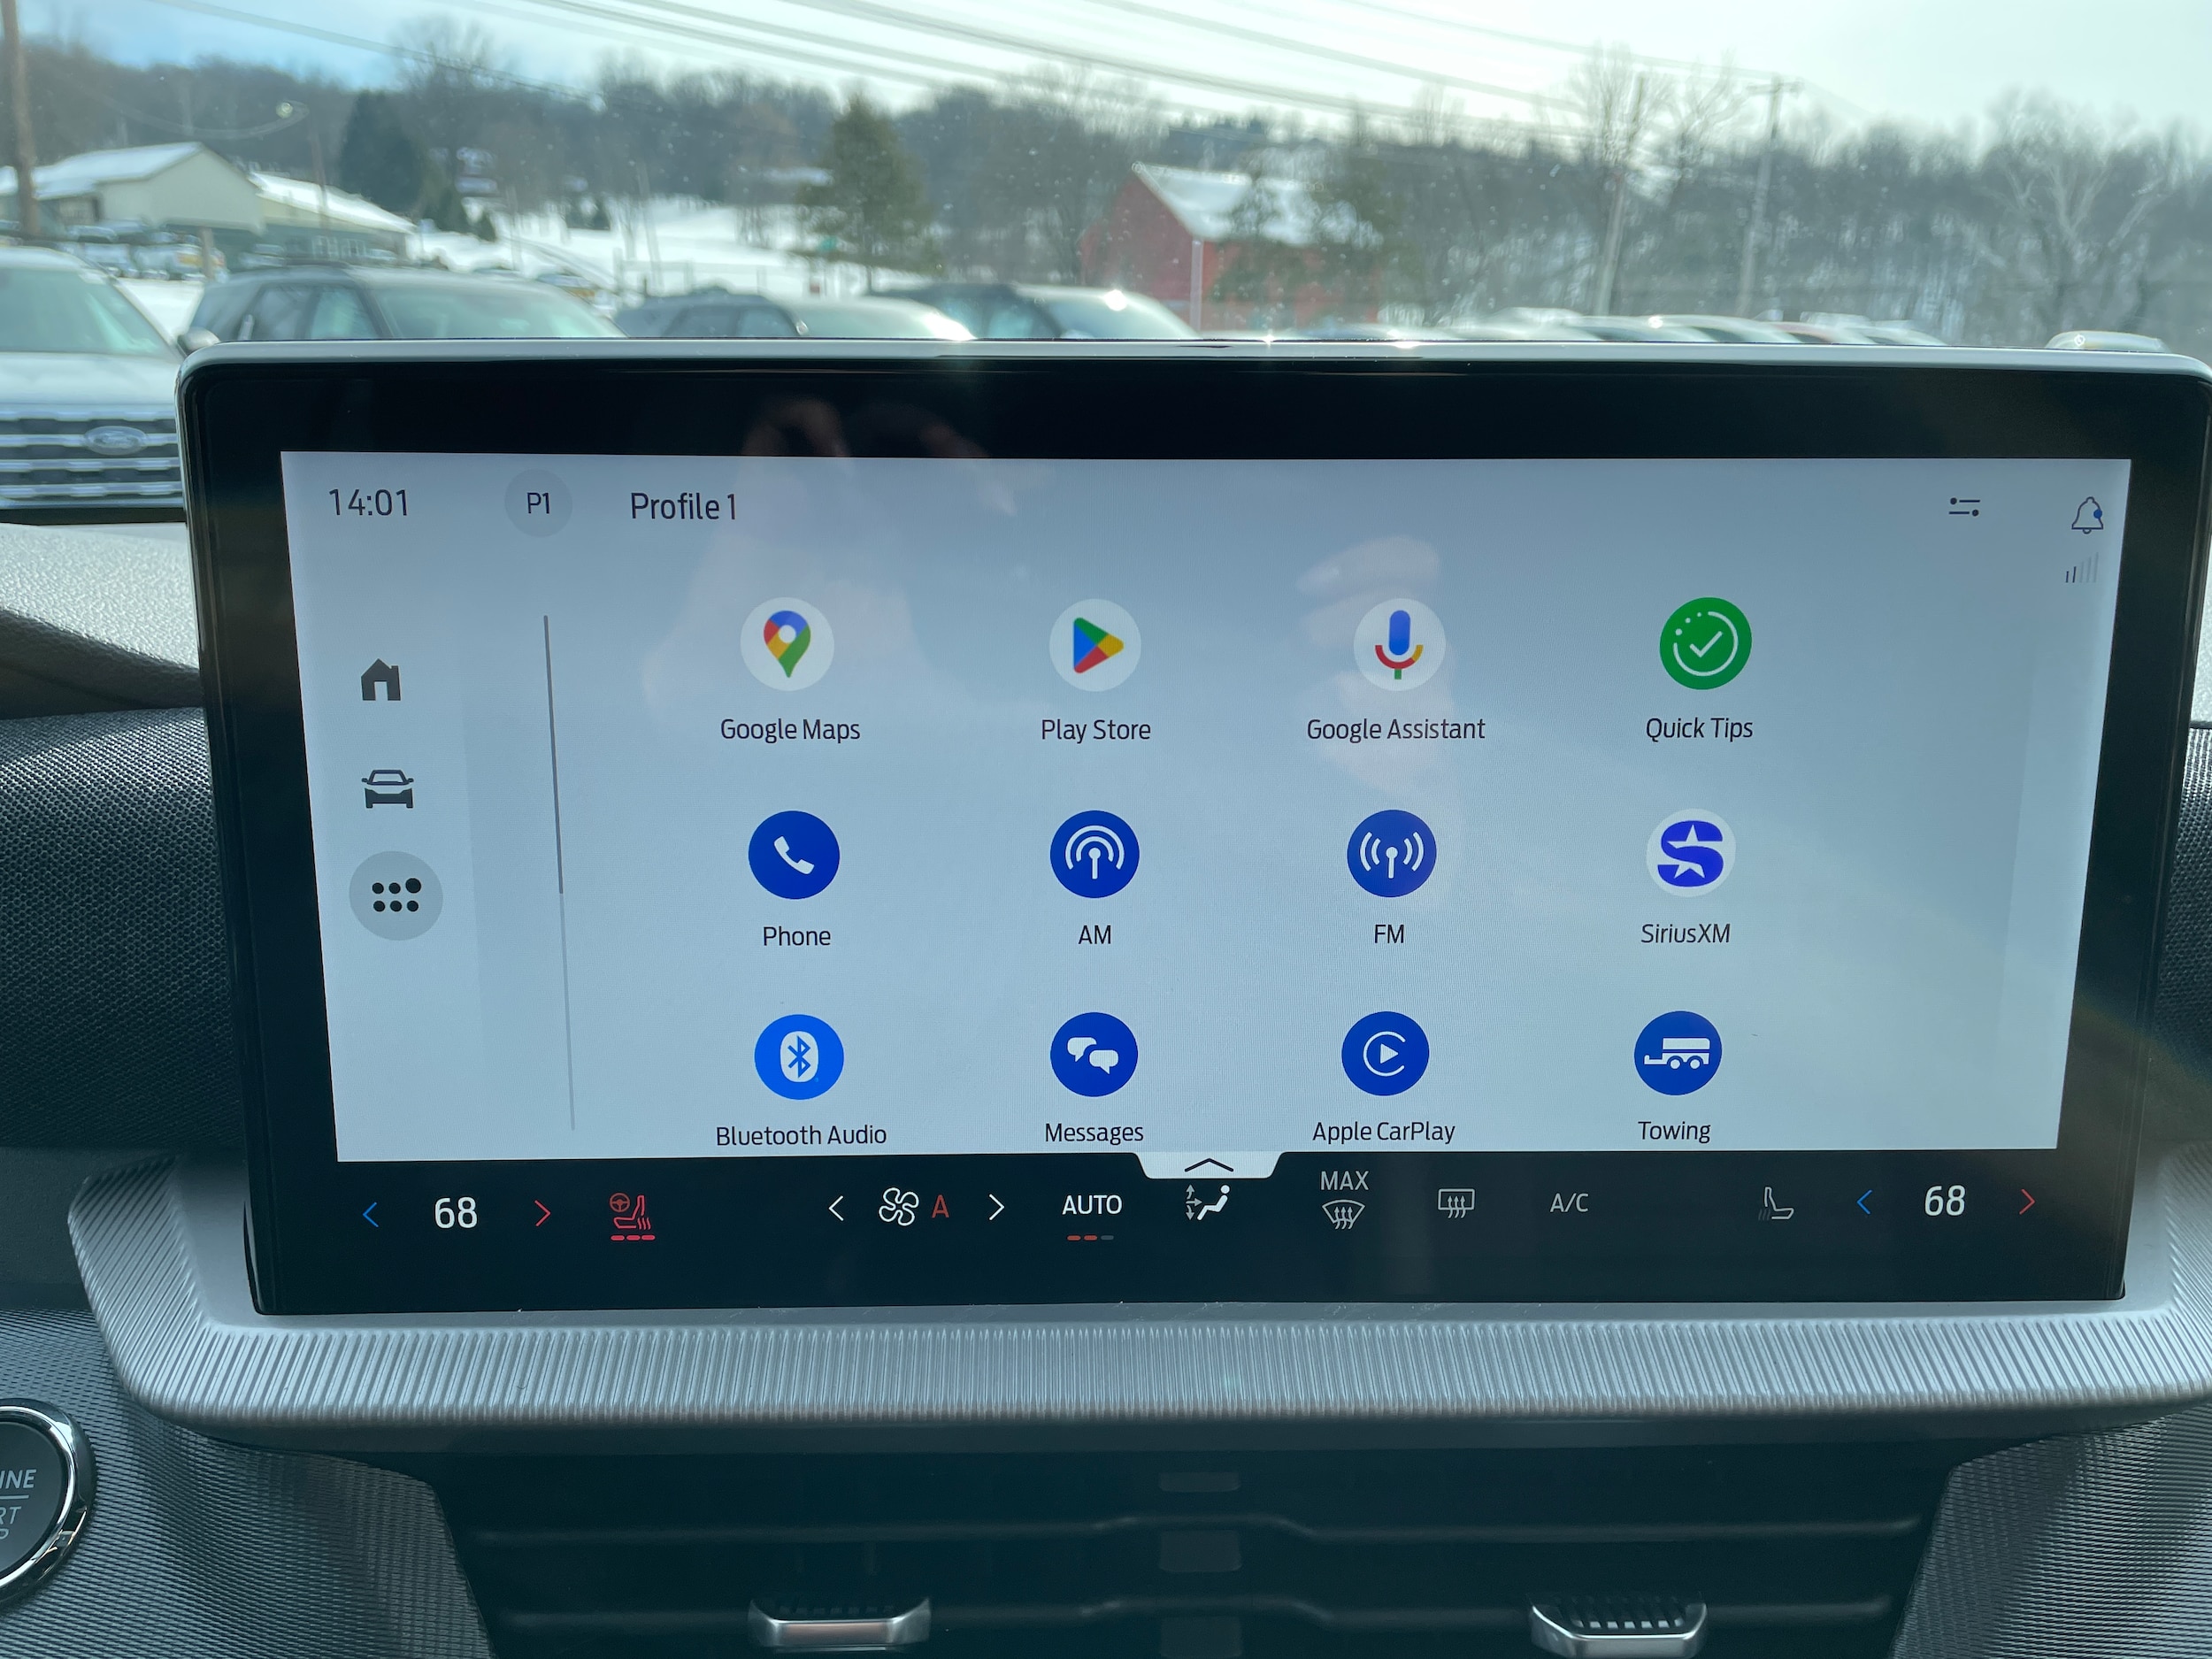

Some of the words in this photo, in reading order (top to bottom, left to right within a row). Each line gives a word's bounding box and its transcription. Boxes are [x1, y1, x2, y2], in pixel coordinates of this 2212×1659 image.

[328, 488, 407, 517] 14:01
[526, 492, 550, 514] P1
[631, 492, 720, 520] Profile
[726, 493, 736, 520] 1
[720, 718, 797, 744] Google
[803, 718, 861, 744] Maps
[1041, 718, 1086, 744] Play
[1093, 719, 1151, 740] Store
[1307, 718, 1382, 744] Google
[1386, 718, 1486, 740] Assistant
[1646, 717, 1706, 743] Quick
[1710, 717, 1753, 743] Tips
[763, 926, 831, 947] Phone
[1078, 925, 1111, 945] AM
[1374, 924, 1405, 944] FM
[1640, 923, 1731, 943] SiriusXM
[716, 1125, 822, 1146] Bluetooth
[827, 1124, 887, 1145] Audio
[1045, 1123, 1144, 1146] Messages
[1312, 1120, 1372, 1145] Apple
[1377, 1120, 1455, 1145] CarPlay
[1637, 1121, 1711, 1144] Towing
[1320, 1171, 1370, 1191] MAX
[434, 1196, 478, 1229] 68
[931, 1194, 949, 1218] A
[1062, 1194, 1123, 1216] AUTO
[1549, 1193, 1589, 1213] A/C
[1924, 1185, 1966, 1217] 68
